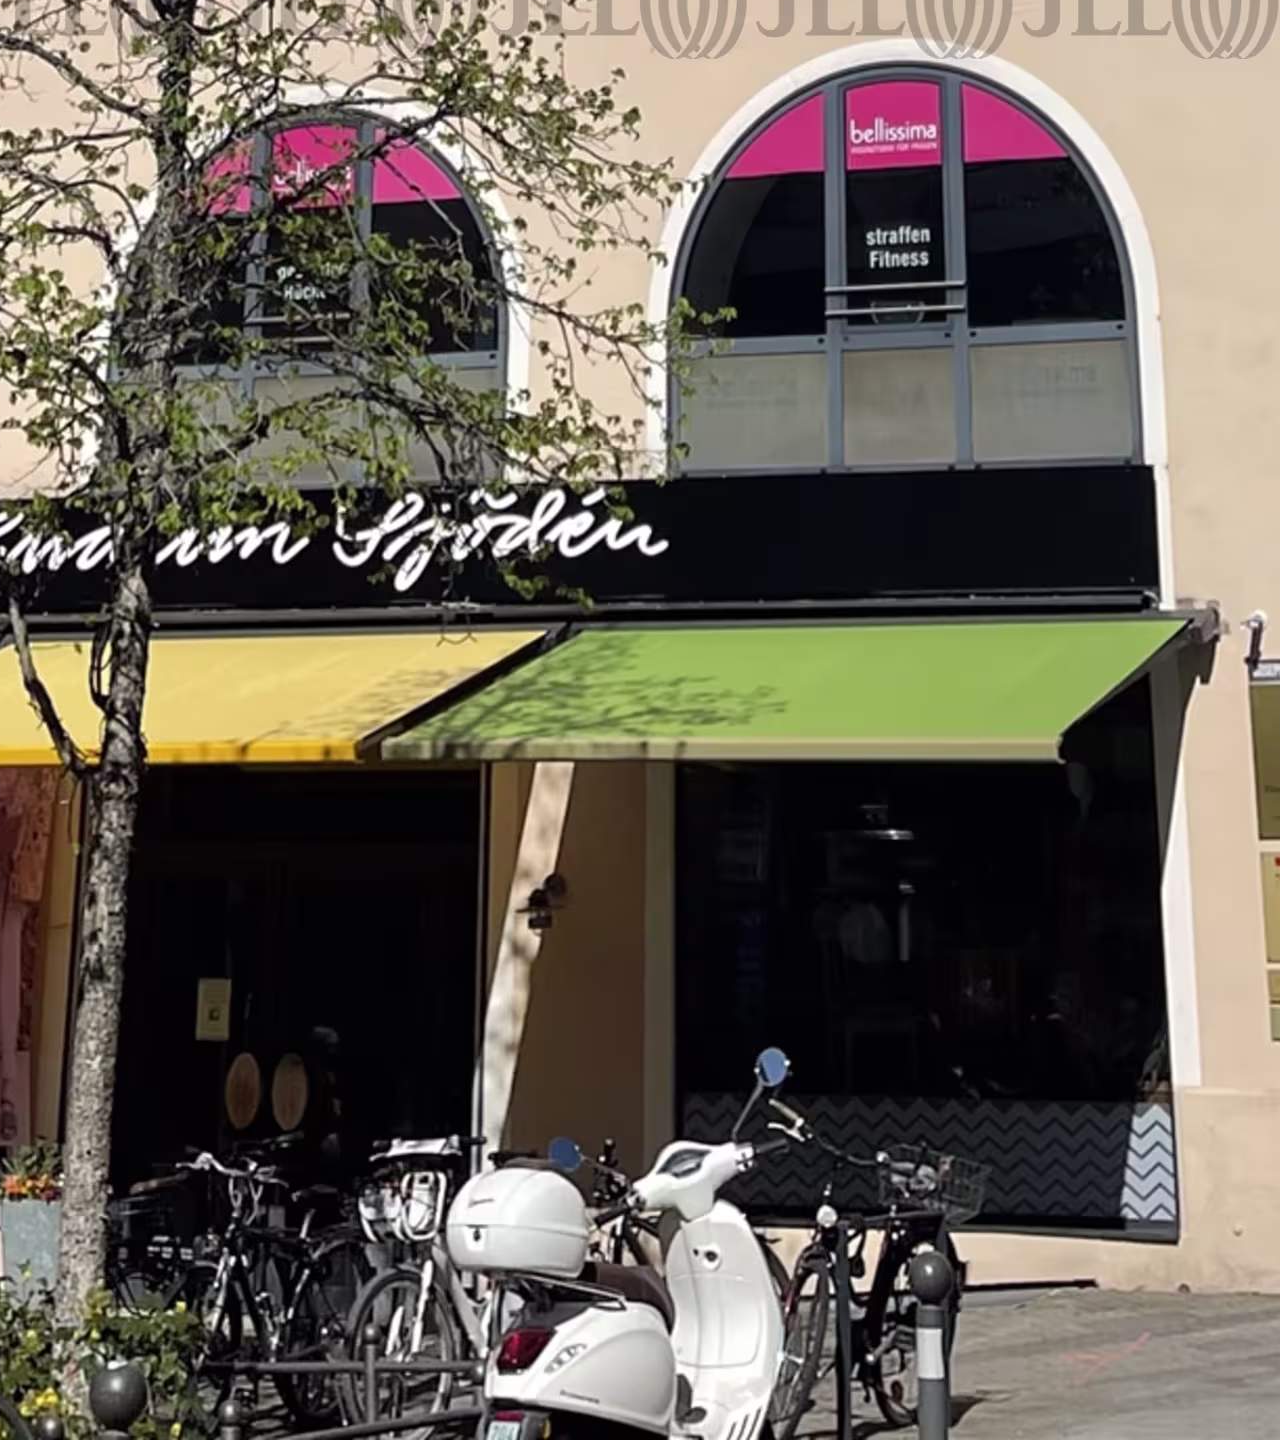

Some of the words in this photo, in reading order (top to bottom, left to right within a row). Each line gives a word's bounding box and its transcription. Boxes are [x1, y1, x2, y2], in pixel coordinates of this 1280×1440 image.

[850, 117, 937, 144] bellissima
[866, 225, 931, 246] straffen
[870, 251, 929, 269] Fitness
